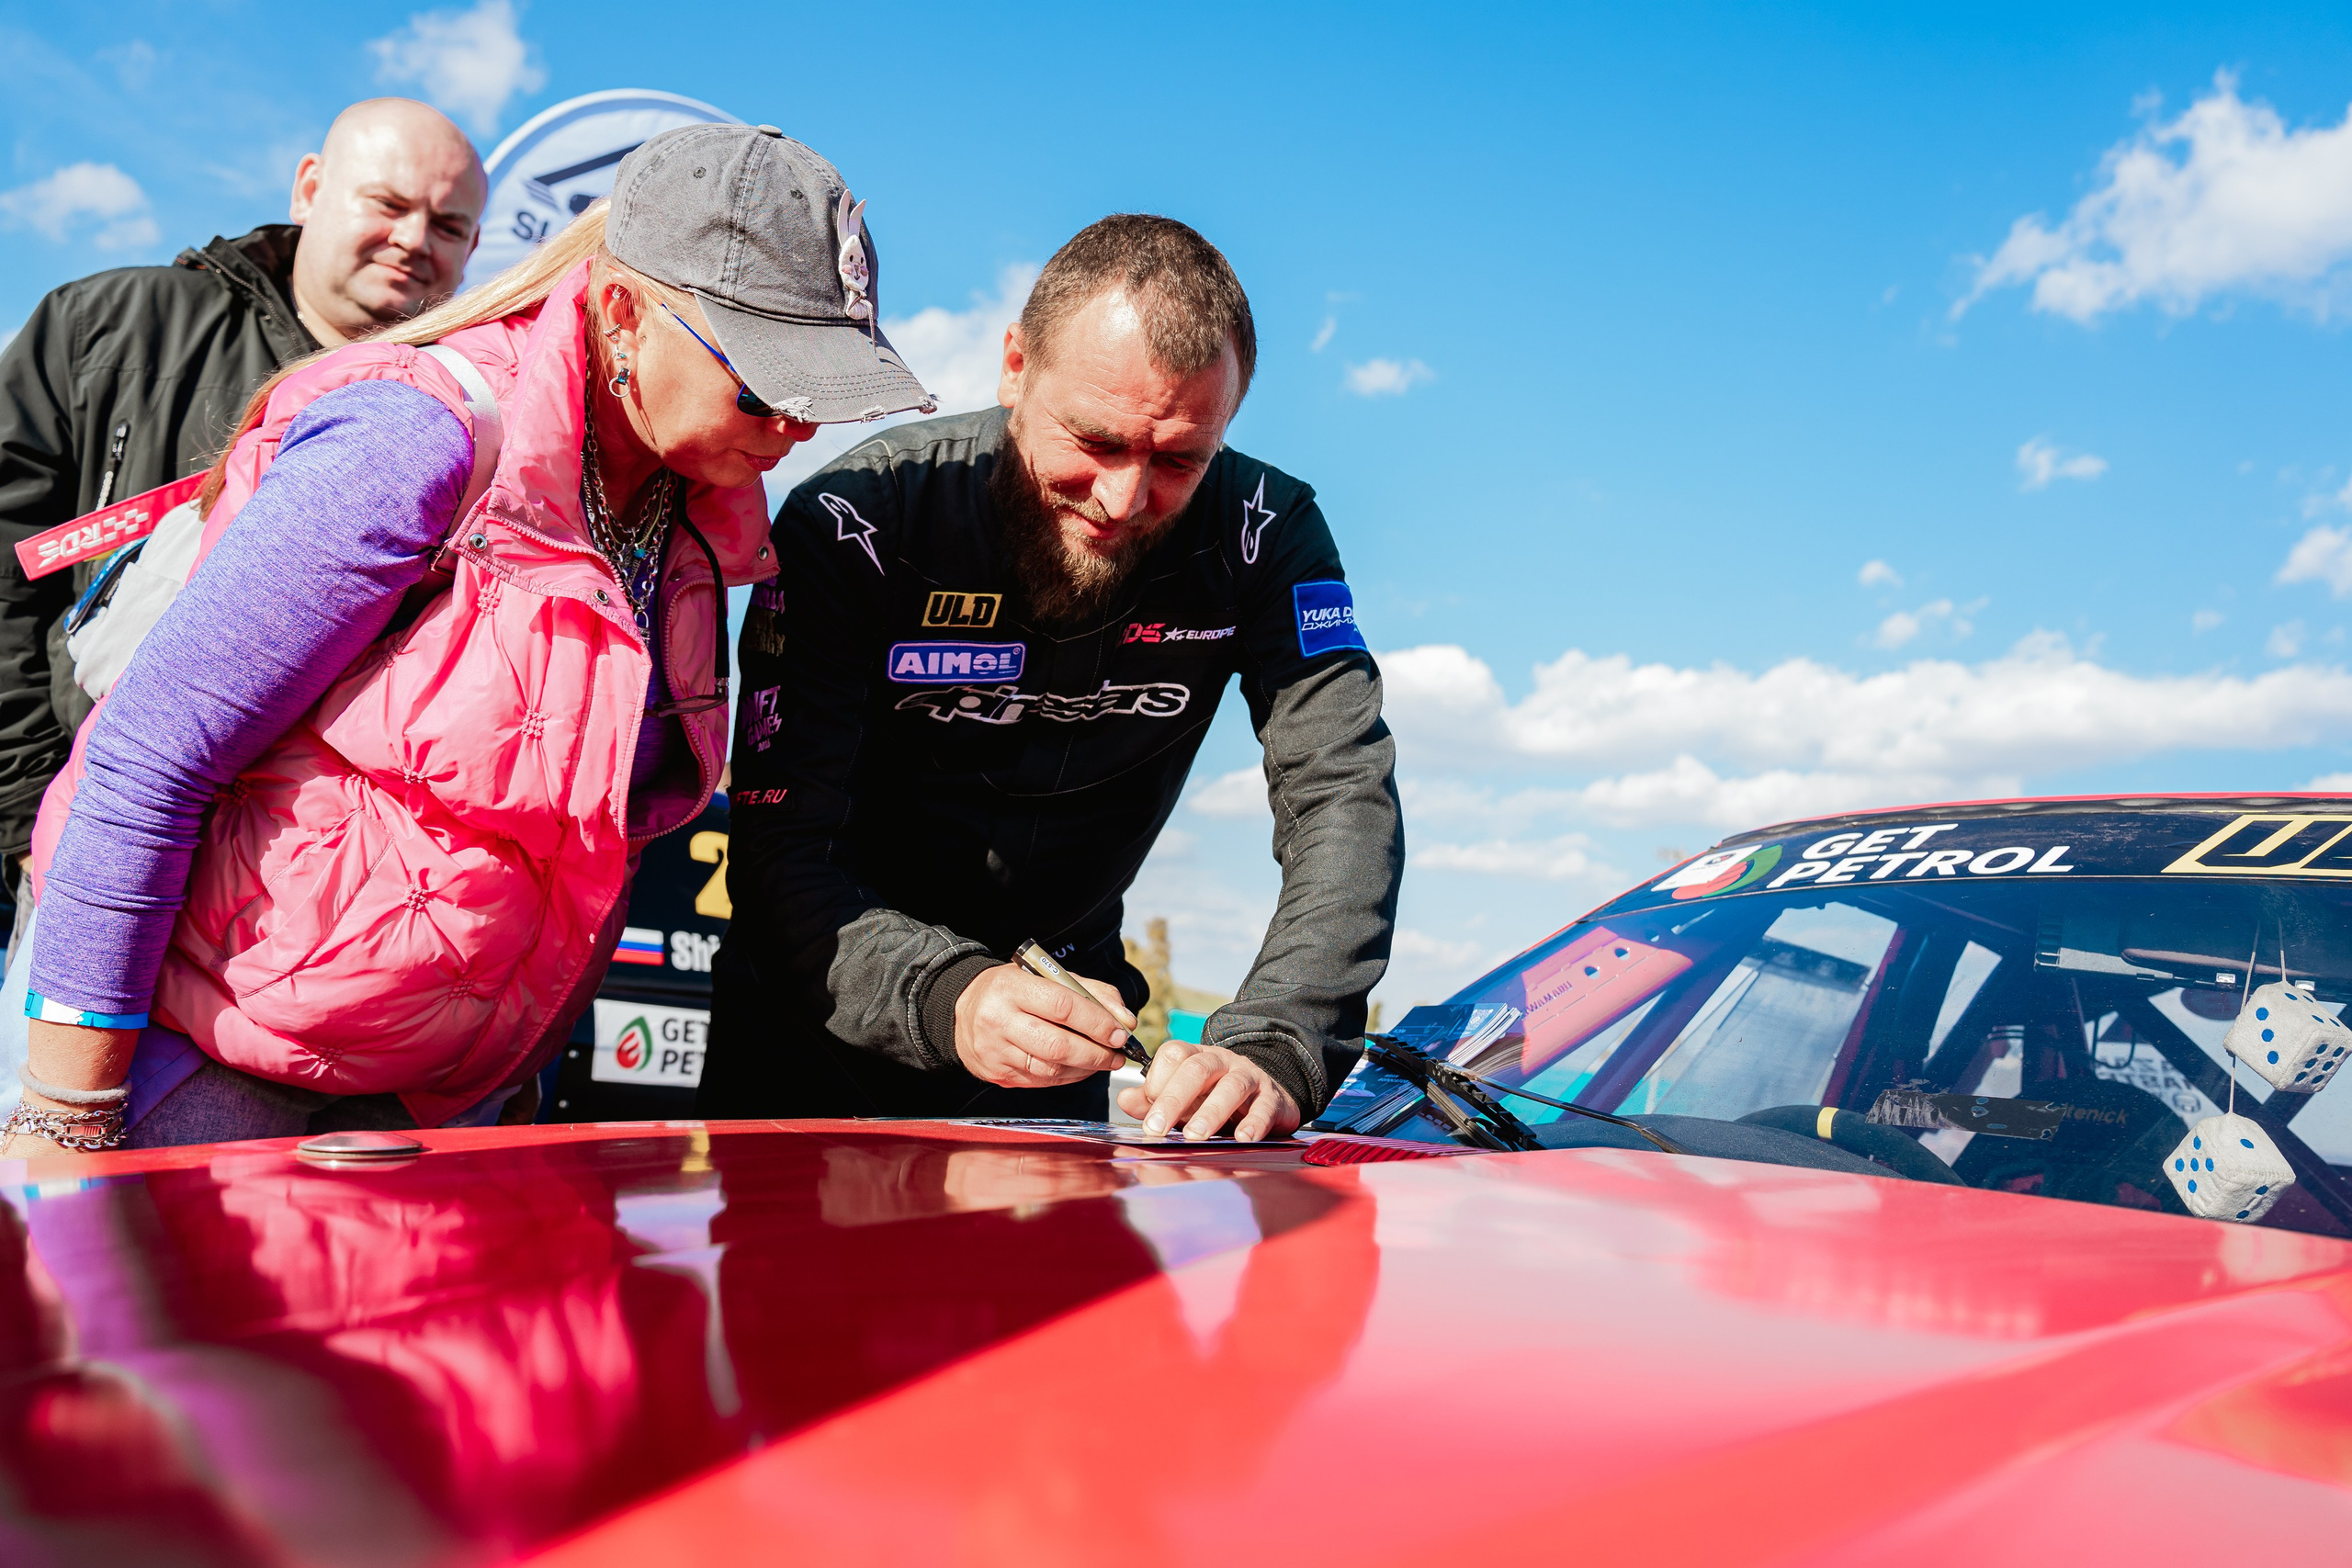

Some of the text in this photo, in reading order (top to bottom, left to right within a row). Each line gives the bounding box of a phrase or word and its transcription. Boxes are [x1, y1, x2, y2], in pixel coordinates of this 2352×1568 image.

[927, 593, 997, 626] ULD
[1302, 606, 1341, 623] YUKA
[1116, 622, 1238, 647] DS EUROPE
[894, 651, 1018, 675] AIMOL
[1802, 823, 1959, 860] GET
[1766, 845, 2075, 889] PETROL
[1042, 957, 1059, 974] C-570
